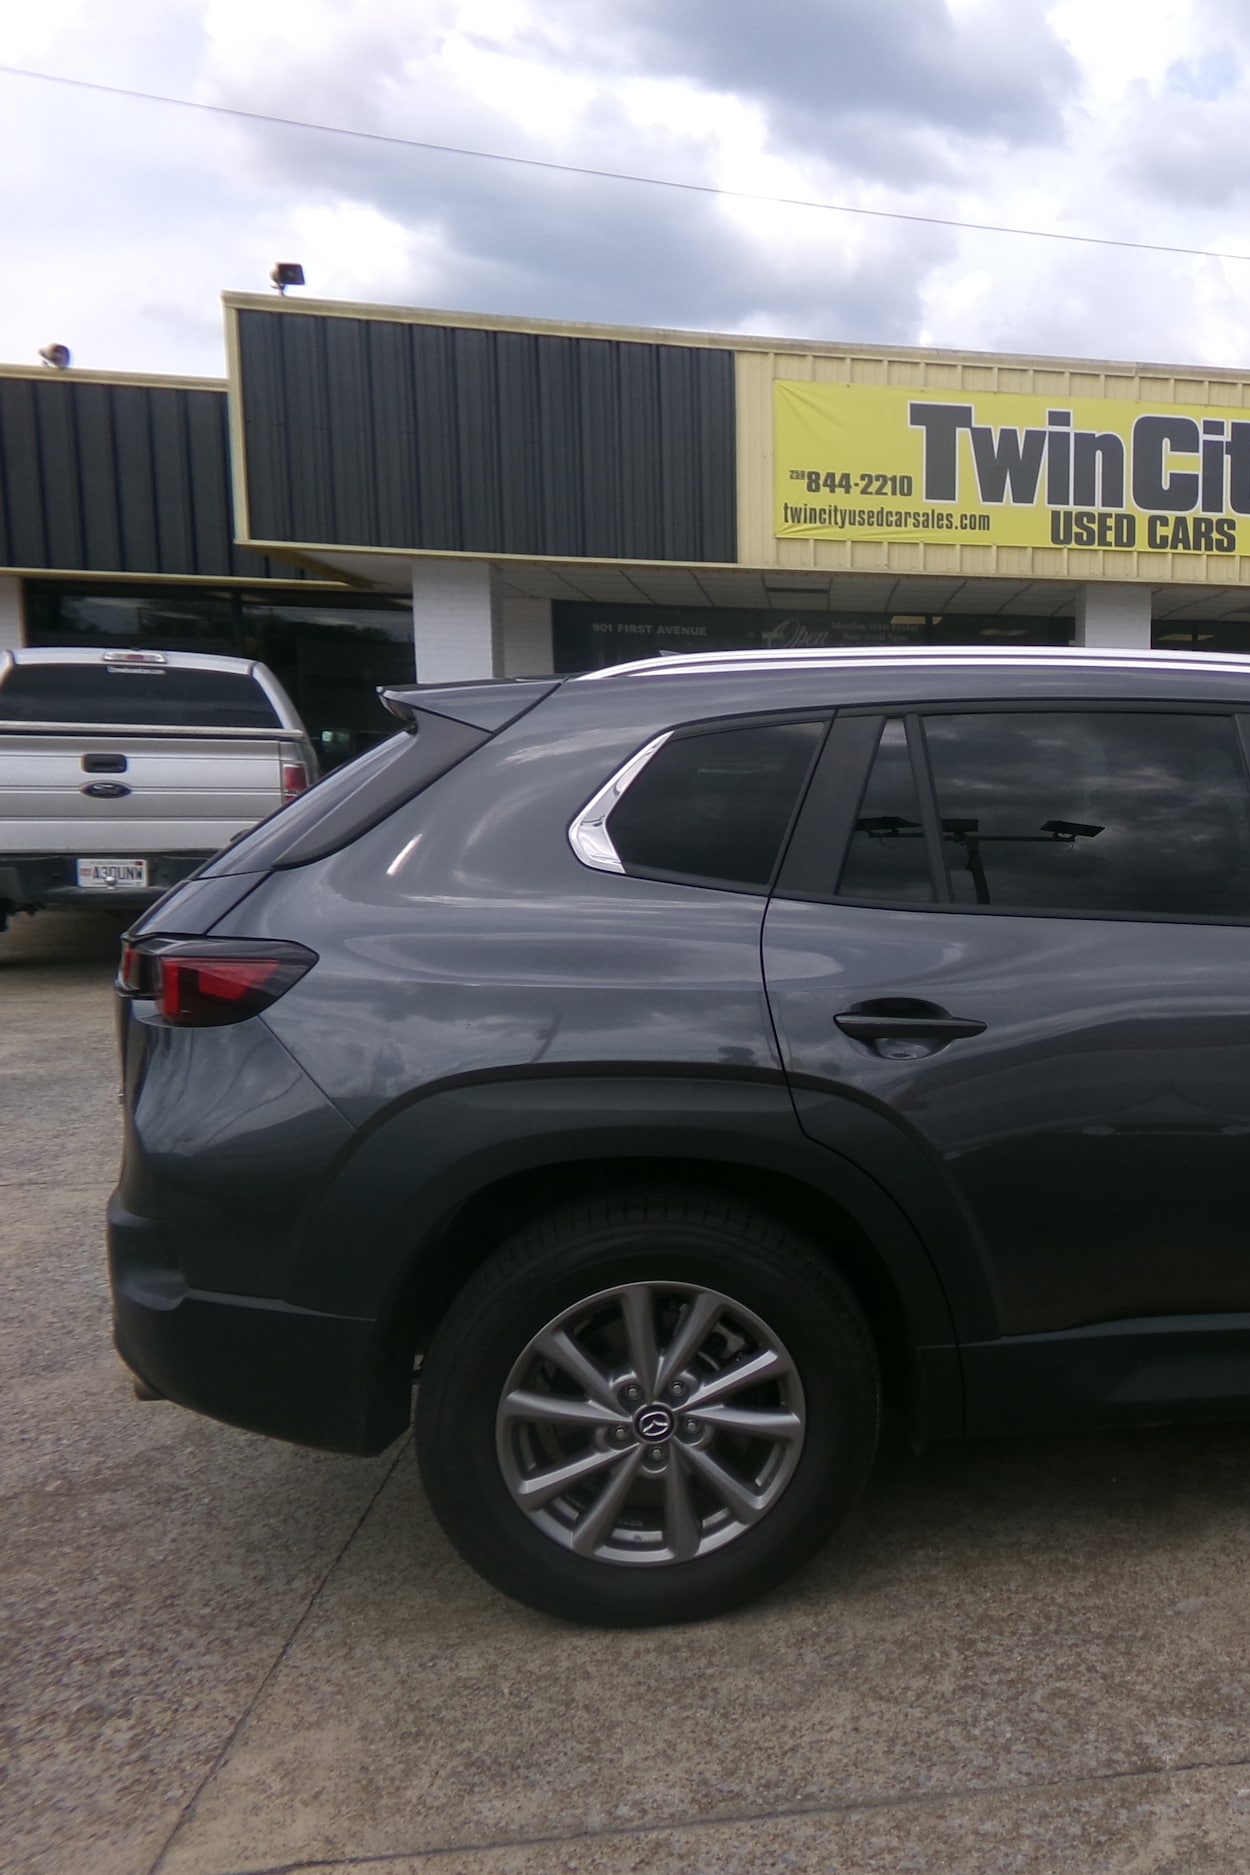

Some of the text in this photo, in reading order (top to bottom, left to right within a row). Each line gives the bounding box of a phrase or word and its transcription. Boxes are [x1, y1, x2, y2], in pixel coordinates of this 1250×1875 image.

[806, 471, 912, 497] 844-2210
[784, 502, 990, 531] twincityusedcarsales.com
[1051, 510, 1236, 552] USED CARS
[592, 623, 707, 636] 901 FIRST AVENUE
